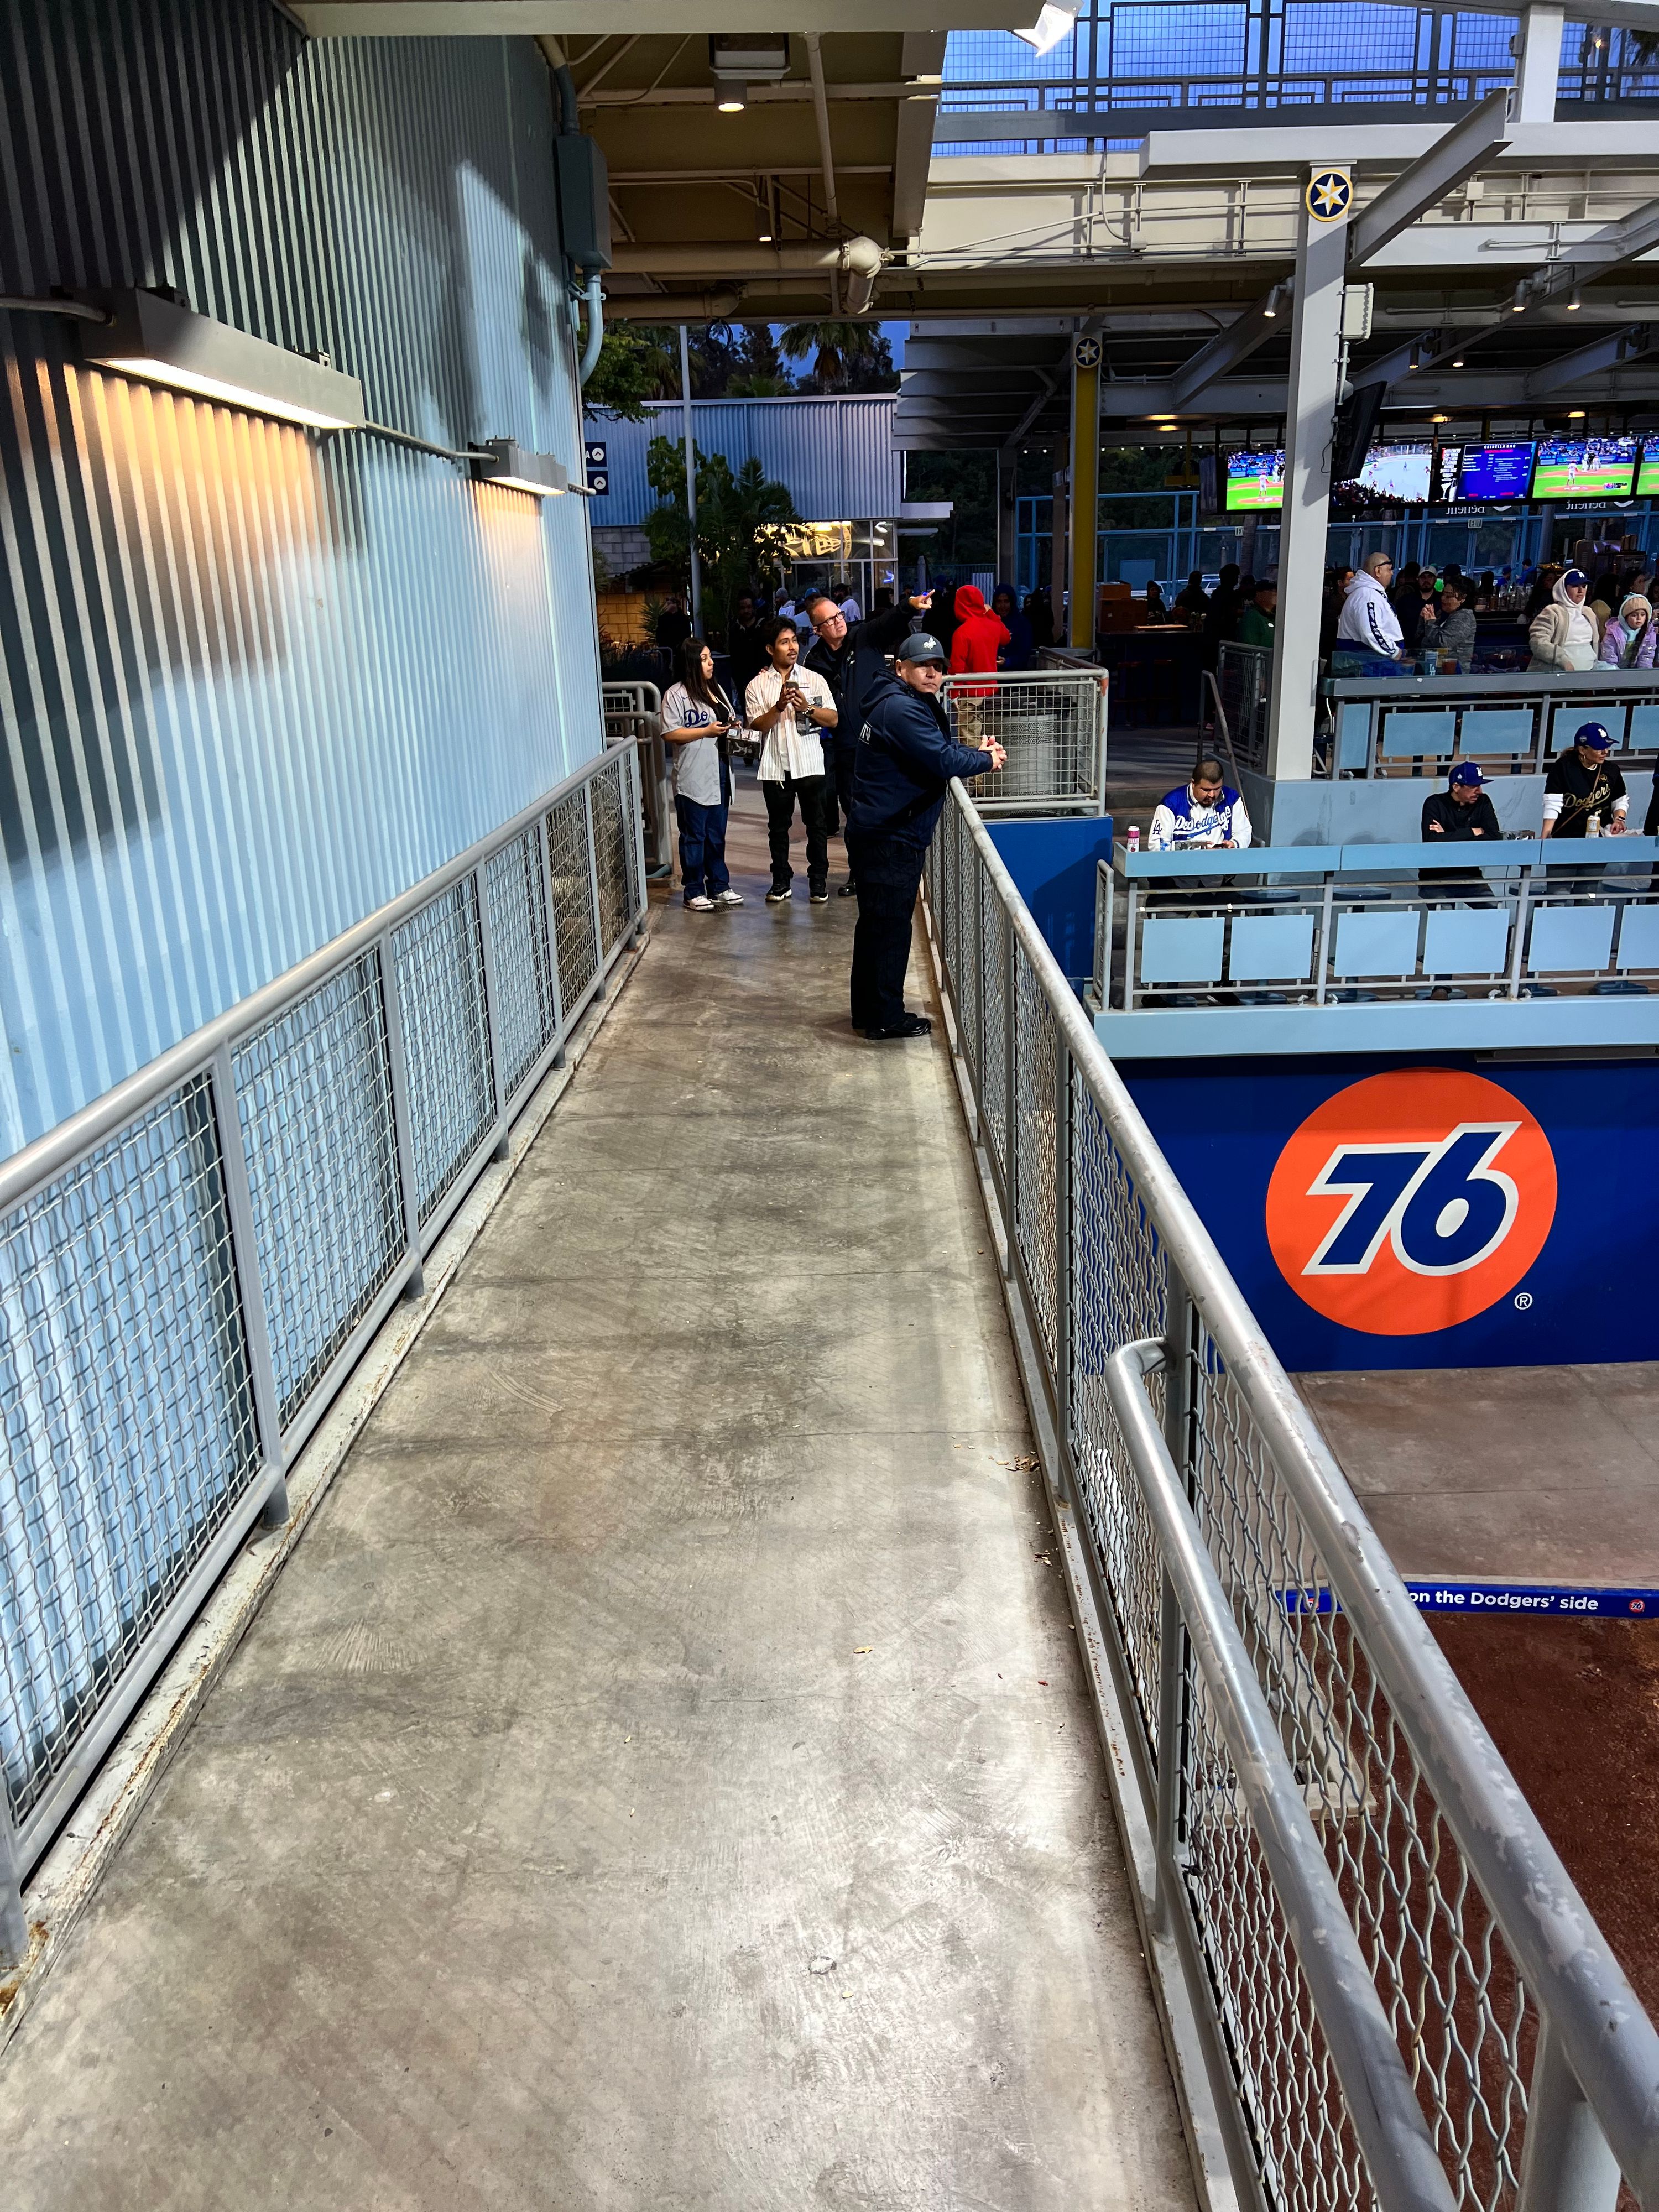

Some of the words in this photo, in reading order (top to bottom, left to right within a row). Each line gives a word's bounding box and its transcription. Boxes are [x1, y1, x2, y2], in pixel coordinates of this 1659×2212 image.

[1301, 1121, 1522, 1276] 76
[1436, 1590, 1464, 1604] the
[1560, 1596, 1599, 1610] side
[1631, 1601, 1644, 1610] 76
